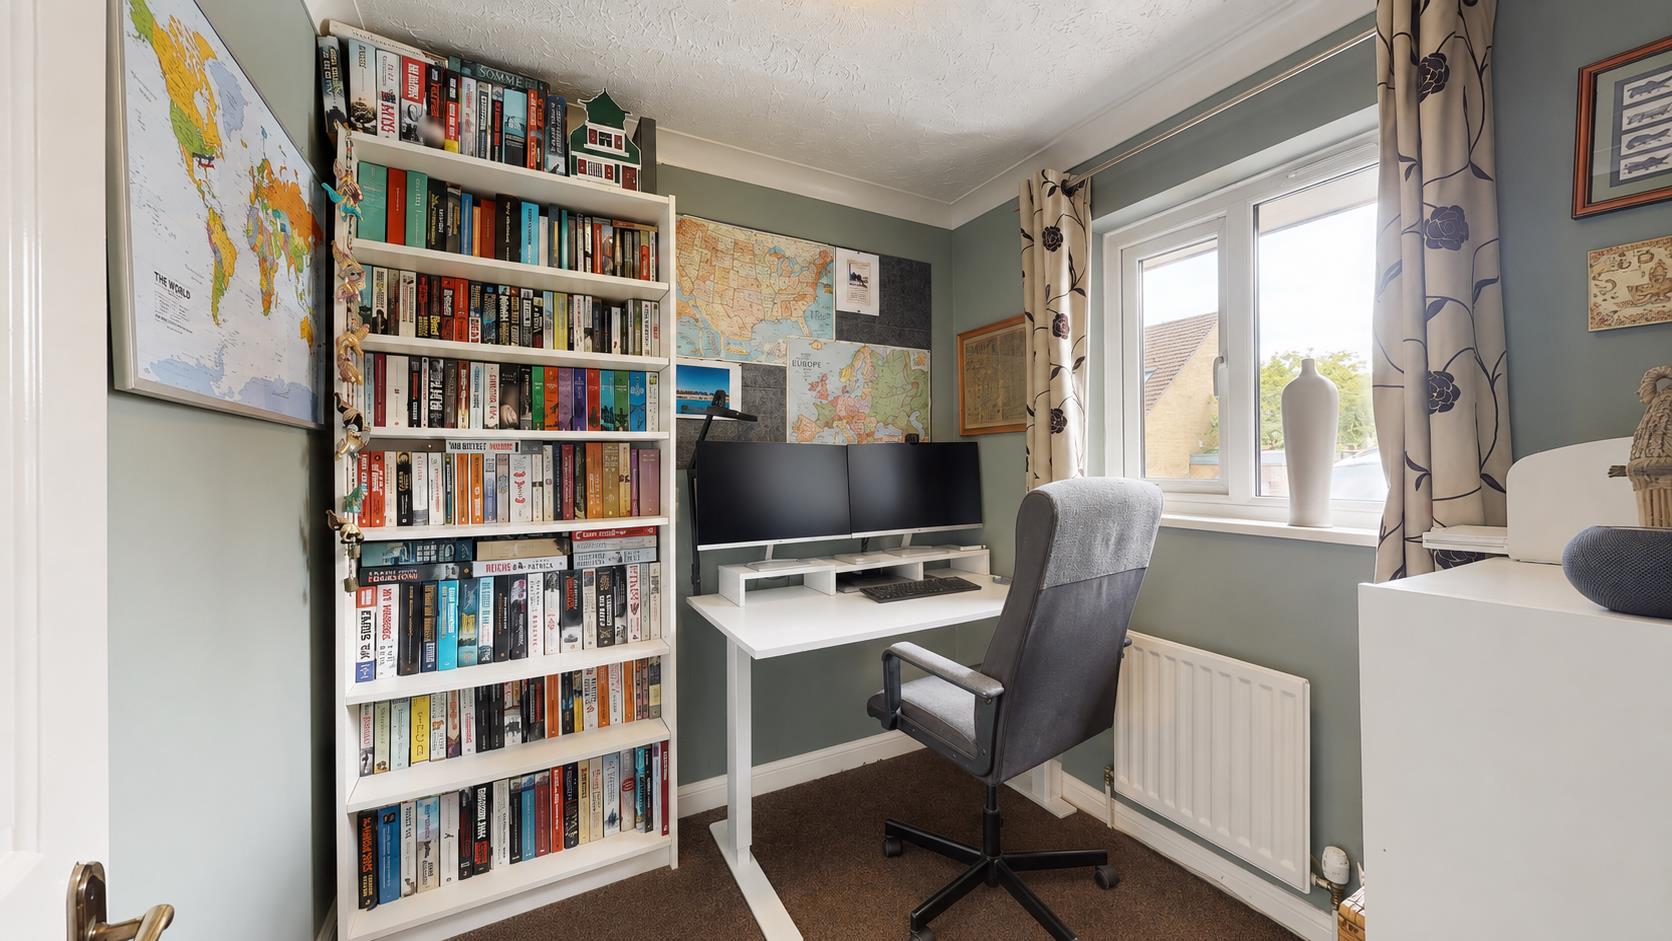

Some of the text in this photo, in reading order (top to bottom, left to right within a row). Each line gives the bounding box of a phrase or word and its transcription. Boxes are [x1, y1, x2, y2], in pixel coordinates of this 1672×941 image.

[479, 65, 522, 87] SOMME
[154, 271, 191, 300] THE WORLD
[791, 360, 822, 368] EUROPE
